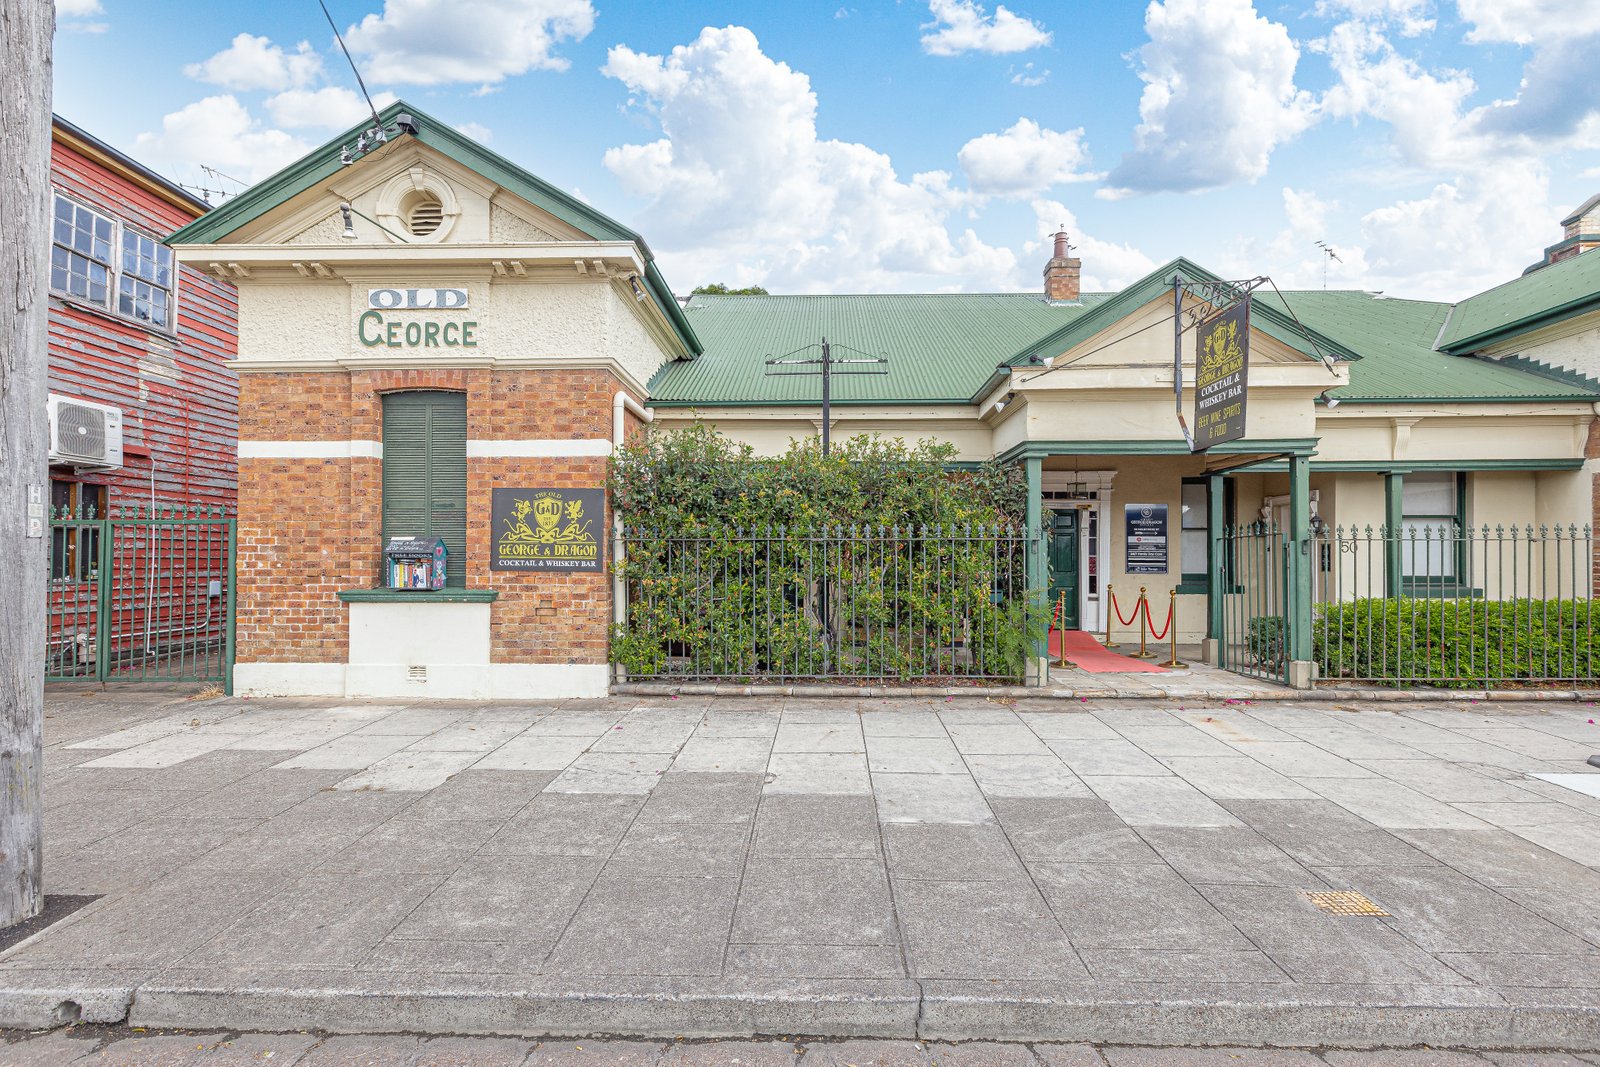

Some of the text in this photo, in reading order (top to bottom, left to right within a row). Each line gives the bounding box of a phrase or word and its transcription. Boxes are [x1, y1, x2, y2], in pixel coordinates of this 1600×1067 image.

[369, 289, 467, 308] OLD
[358, 310, 478, 347] GEORGE
[1201, 372, 1240, 397] COCKTAIL &
[1199, 385, 1242, 410] WHISKEY BAR
[1198, 402, 1241, 429] BEER WINE SPIRITS
[1214, 423, 1227, 437] FOOD
[535, 491, 562, 499] THE OLD
[499, 544, 597, 556] GEORGE & DRAGON
[1341, 541, 1358, 554] 50
[499, 559, 538, 567] COCKTAIL
[546, 559, 580, 567] WHISKEY
